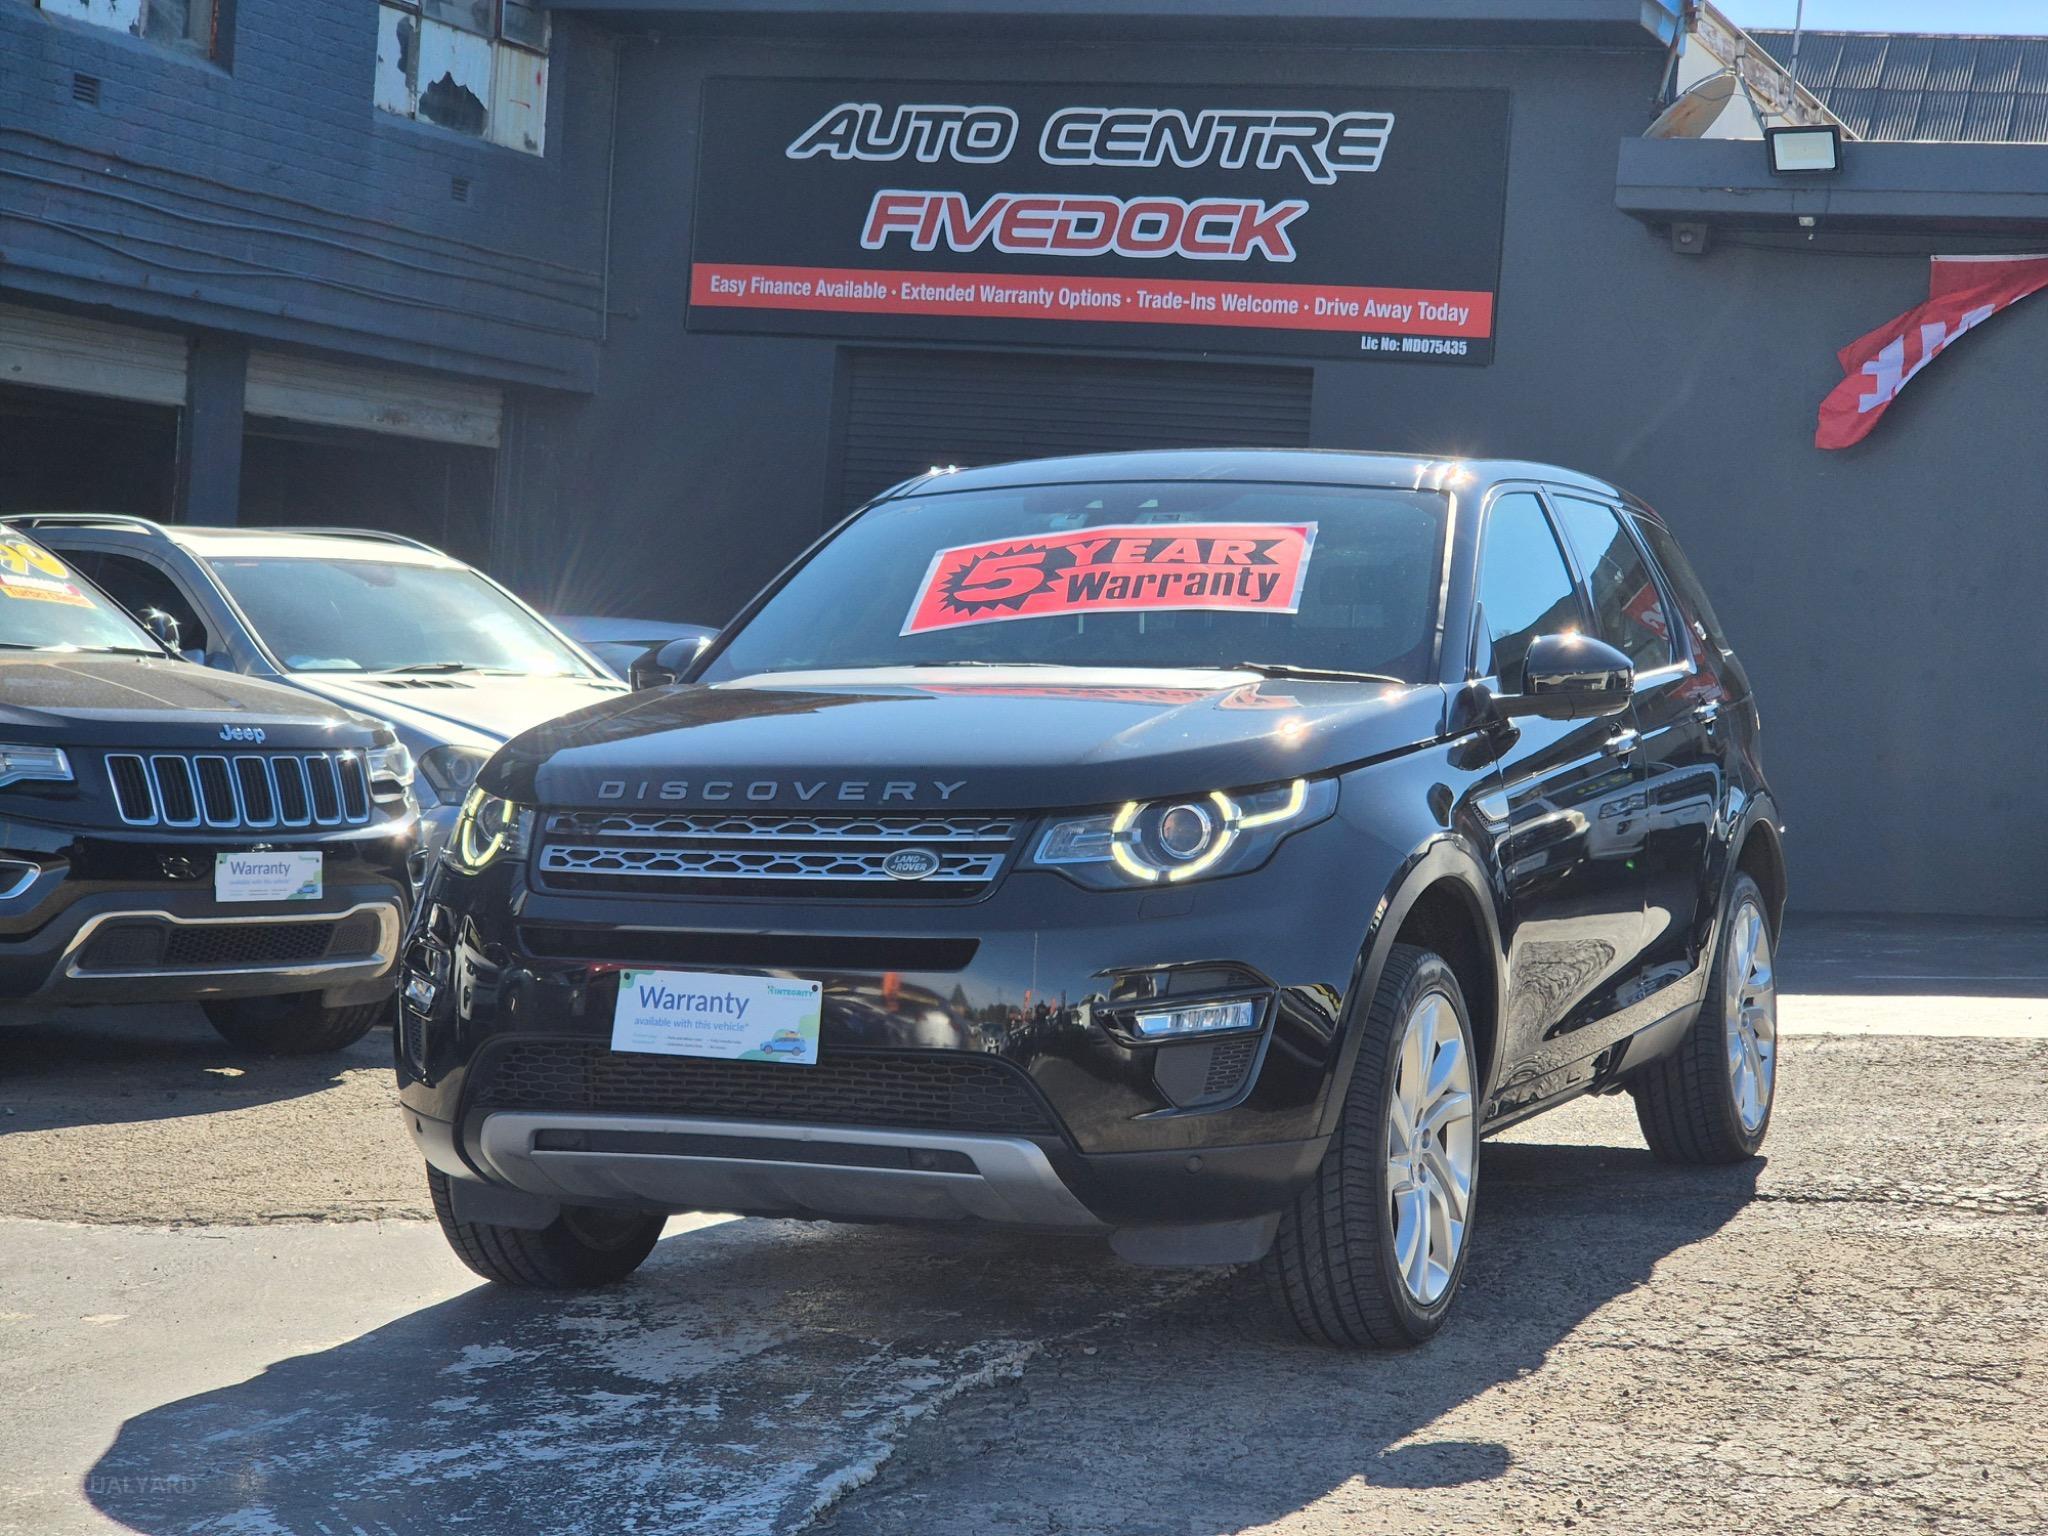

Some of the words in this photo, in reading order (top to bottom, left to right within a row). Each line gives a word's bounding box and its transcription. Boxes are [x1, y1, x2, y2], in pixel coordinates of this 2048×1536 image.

[787, 103, 1019, 164] AUTO
[1038, 107, 1395, 186] CENTRE
[860, 189, 1309, 264] FIVEDOCK
[710, 275, 747, 297] Easy
[750, 276, 812, 297] Finance
[815, 279, 887, 300] Available
[901, 282, 975, 303] Extended
[980, 285, 1054, 308] Warranty
[1058, 288, 1122, 310] Options
[1136, 290, 1217, 312] Trade-Ins
[1221, 293, 1299, 315] Welcome
[1314, 297, 1359, 318] Drive
[1363, 299, 1413, 323] Away
[1417, 301, 1469, 326] Today
[1361, 336, 1379, 351] Lic
[1381, 337, 1400, 352] No:
[1402, 338, 1468, 356] MD075435
[1066, 537, 1258, 568] YEAR
[953, 552, 1047, 602] 5
[1066, 566, 1281, 604] Warranty
[219, 724, 266, 745] Jeep
[598, 780, 968, 802] DISCOVERY
[230, 861, 291, 877] Warranty
[895, 855, 920, 863] LAND
[896, 863, 928, 871] ROVER
[639, 985, 750, 1019] Warranty
[634, 1016, 671, 1028] available
[673, 1018, 692, 1030] with
[694, 1020, 711, 1031] this
